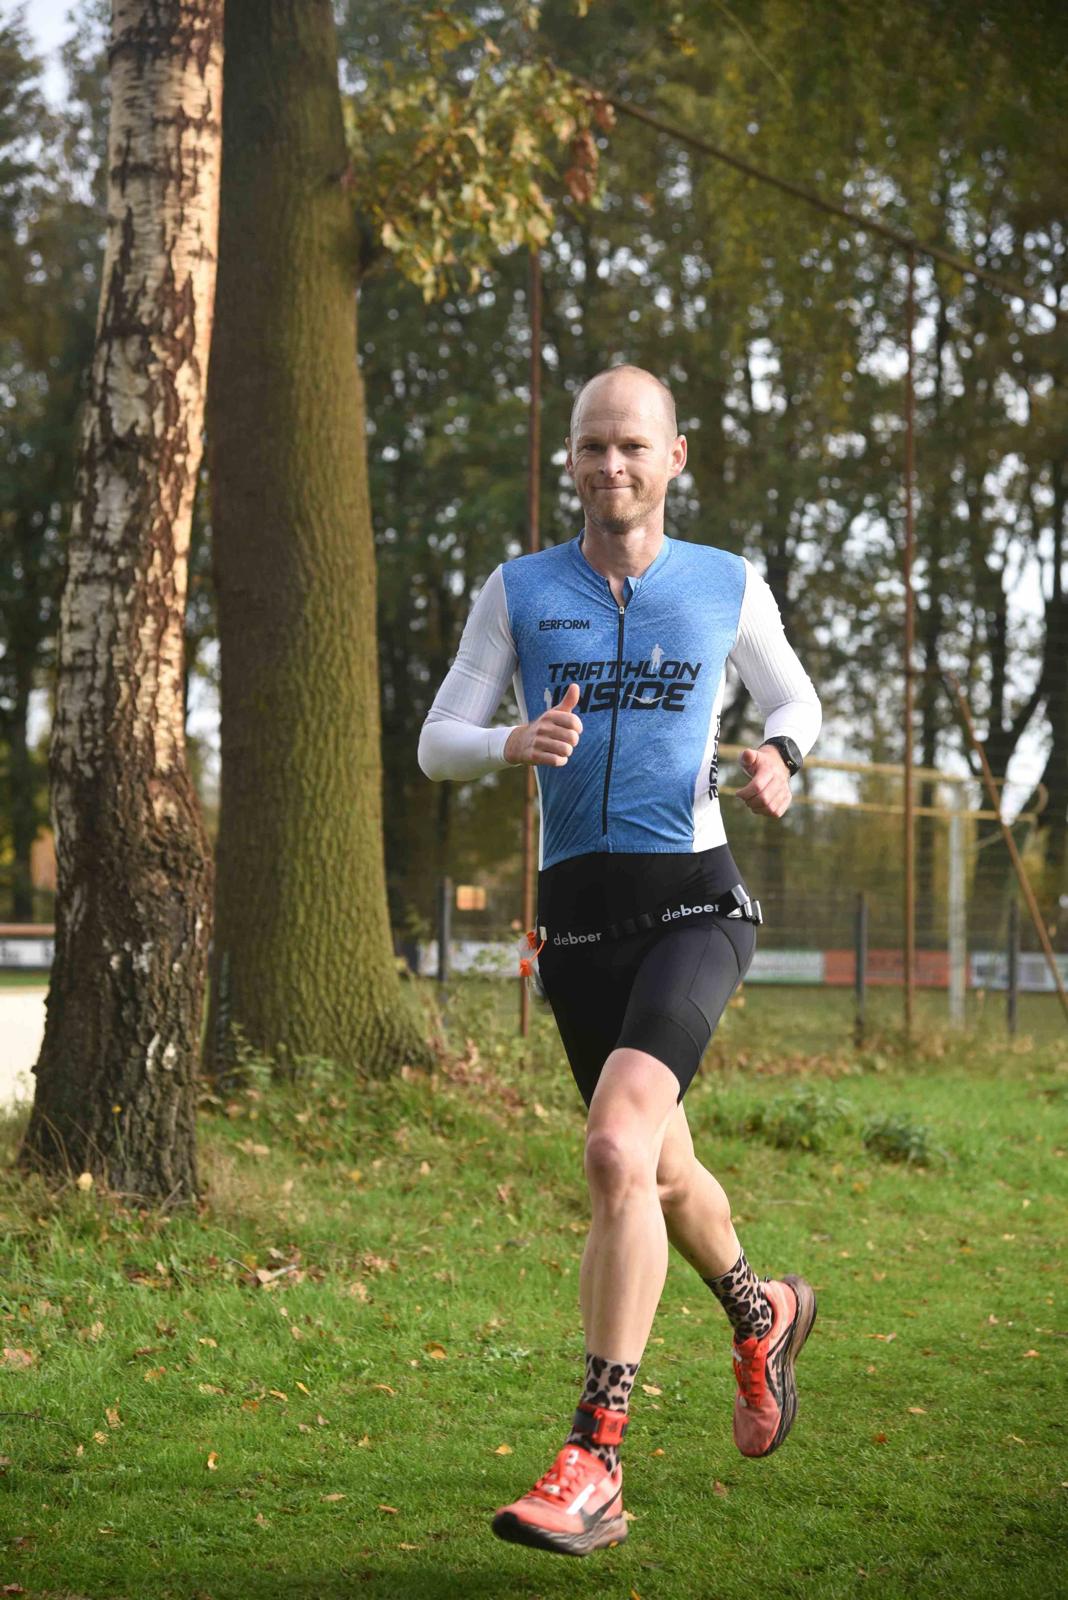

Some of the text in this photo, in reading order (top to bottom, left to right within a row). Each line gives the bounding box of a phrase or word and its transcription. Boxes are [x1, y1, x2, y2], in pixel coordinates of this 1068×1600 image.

[539, 619, 590, 631] PERFORM
[549, 660, 702, 683] TRIATHLON
[661, 904, 721, 923] deboer
[553, 931, 602, 946] deboer
